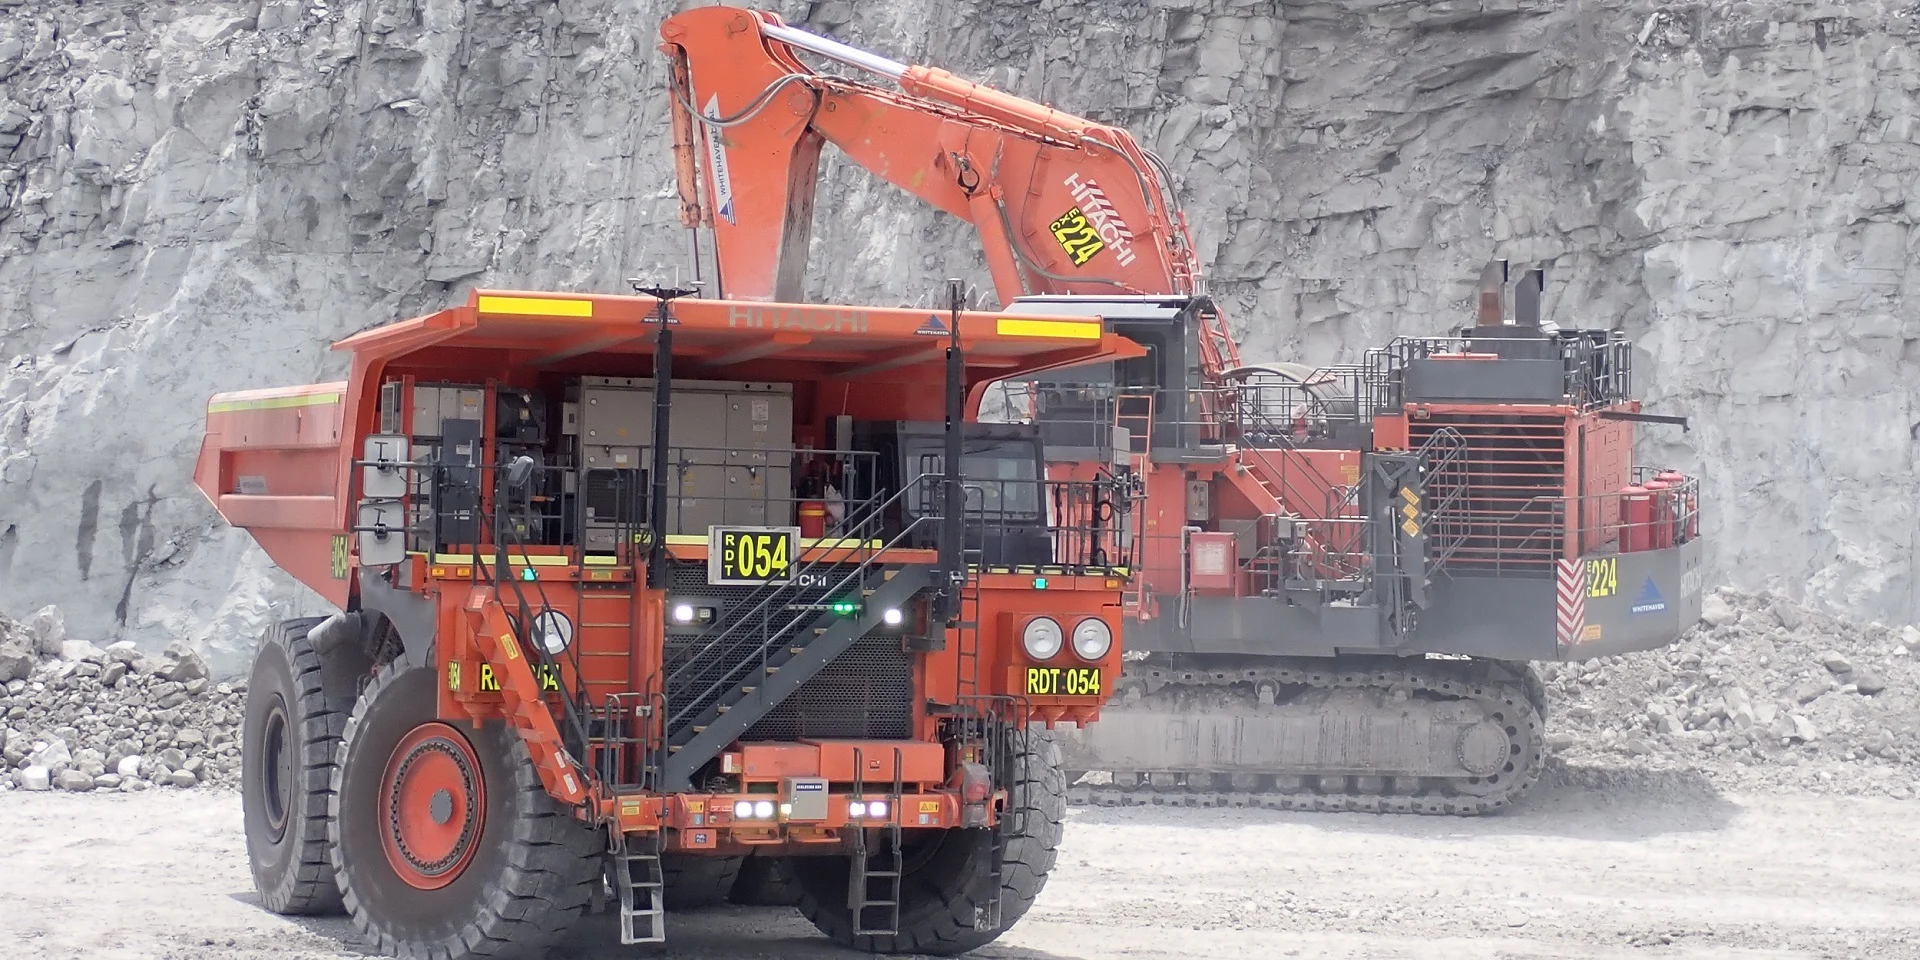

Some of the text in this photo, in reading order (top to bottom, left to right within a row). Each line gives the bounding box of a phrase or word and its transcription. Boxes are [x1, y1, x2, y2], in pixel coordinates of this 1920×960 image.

[712, 136, 727, 196] WHITEHAVEN
[1054, 216, 1104, 265] 224
[1063, 172, 1136, 267] HITACHI
[729, 304, 868, 333] HITACHI
[725, 534, 735, 577] RDT
[738, 534, 789, 577] 054
[1591, 557, 1617, 597] 224
[1631, 602, 1665, 613] WHITEHAVEN
[1027, 668, 1100, 695] RDT 054
